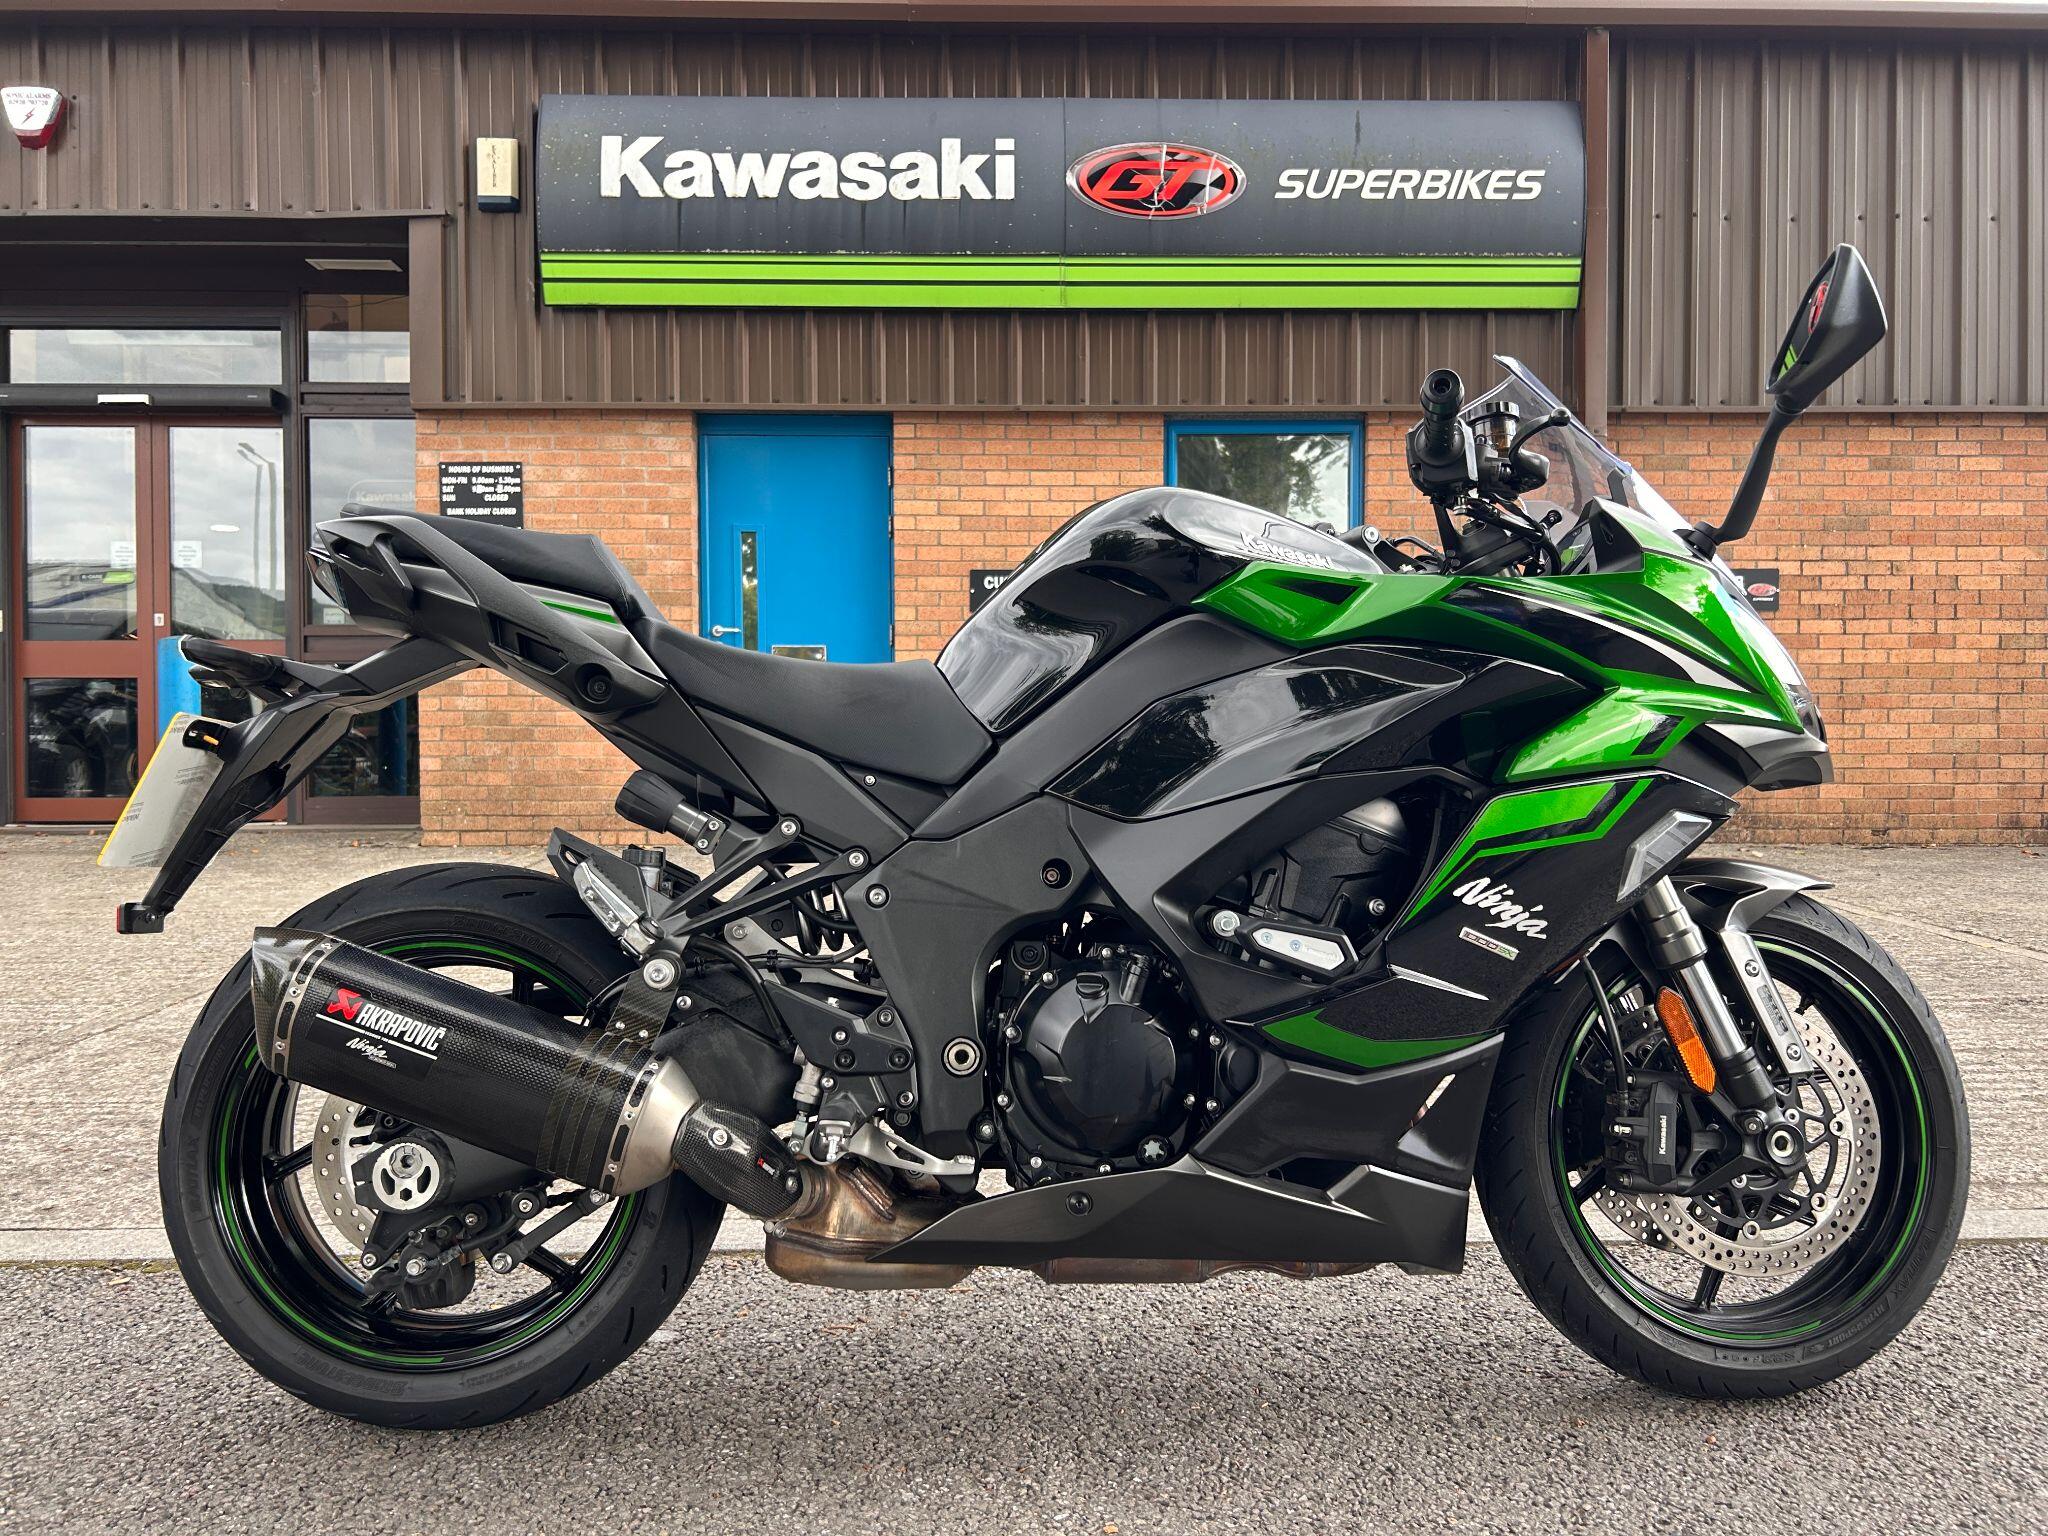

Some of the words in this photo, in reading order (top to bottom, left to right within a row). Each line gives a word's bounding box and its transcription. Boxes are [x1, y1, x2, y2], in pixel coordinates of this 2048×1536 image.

[600, 135, 1016, 200] Kawasaki
[1093, 158, 1222, 201] GT
[1274, 168, 1546, 201] SUPERBIKES
[442, 485, 454, 493] SAT
[442, 494, 456, 502] SUN
[484, 493, 509, 502] CLOSED
[1240, 529, 1334, 569] Kawasaki
[1452, 877, 1548, 939] Ninja
[345, 1037, 388, 1059] Ninja
[1659, 1114, 1667, 1155] Kawasaki
